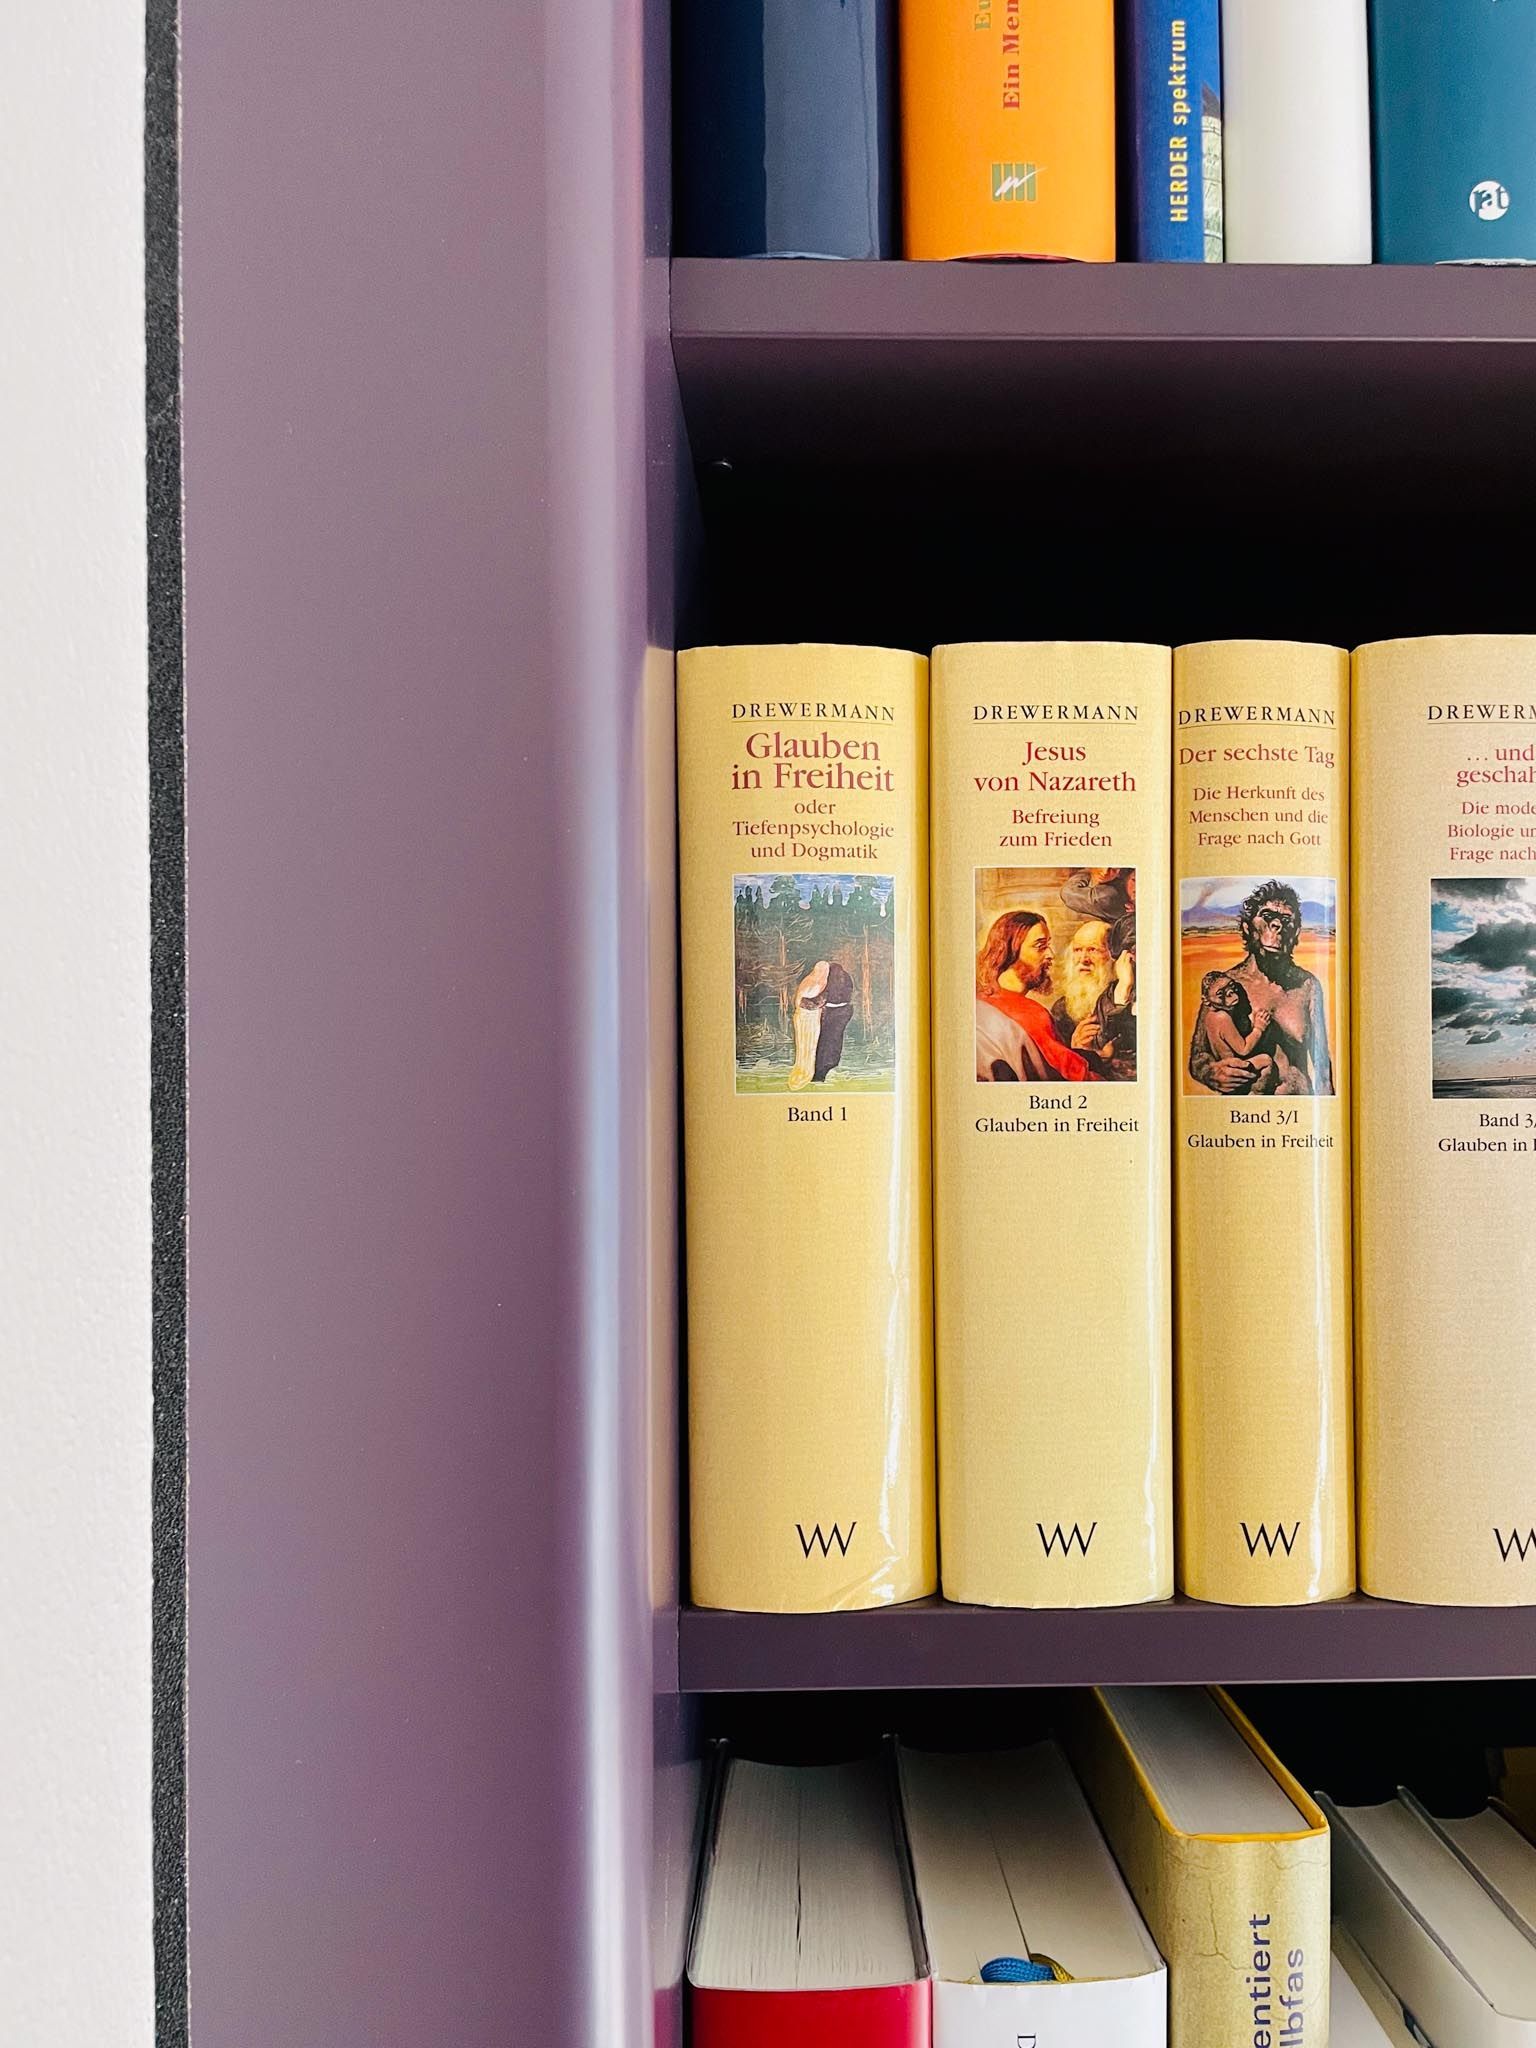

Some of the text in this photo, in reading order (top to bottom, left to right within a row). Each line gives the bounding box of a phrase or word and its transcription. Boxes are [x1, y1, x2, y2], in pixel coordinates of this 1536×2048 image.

[1003, 0, 1020, 110] Ein Men
[1168, 20, 1191, 222] HERDER spektrum
[732, 703, 894, 721] DREWERMANN
[973, 705, 1138, 721] DREWERMANN
[1178, 706, 1335, 725] DREWERMANN
[746, 731, 880, 761] Glauben
[1022, 742, 1086, 766] Jesus
[1496, 744, 1535, 761] und
[1179, 744, 1335, 768] Der sechste Tag
[732, 762, 895, 791] in Freiheit
[974, 771, 1137, 792] von Nazareth
[1193, 785, 1325, 801] Die Herkunft des
[794, 799, 836, 814] oder
[1462, 801, 1490, 815] Die
[1012, 809, 1100, 828] Befreiung
[1189, 808, 1329, 824] Menschen und die
[732, 820, 894, 840] Tiefenpsychologie
[1448, 824, 1515, 841] Biologie
[1000, 832, 1112, 847] zum Frieden
[1198, 831, 1321, 848] Frage nach Gott
[751, 842, 878, 861] und Dogmatik
[1450, 846, 1536, 863] Frage nach
[1029, 1095, 1088, 1110] Band 2
[788, 1106, 848, 1121] Band 1
[1230, 1110, 1271, 1124] Band
[1480, 1113, 1519, 1127] Band
[975, 1117, 1139, 1132] Glauben in Freiheit
[1187, 1134, 1334, 1148] Glauben in Freiheit
[1438, 1138, 1507, 1152] Glauben
[1512, 1138, 1527, 1152] in
